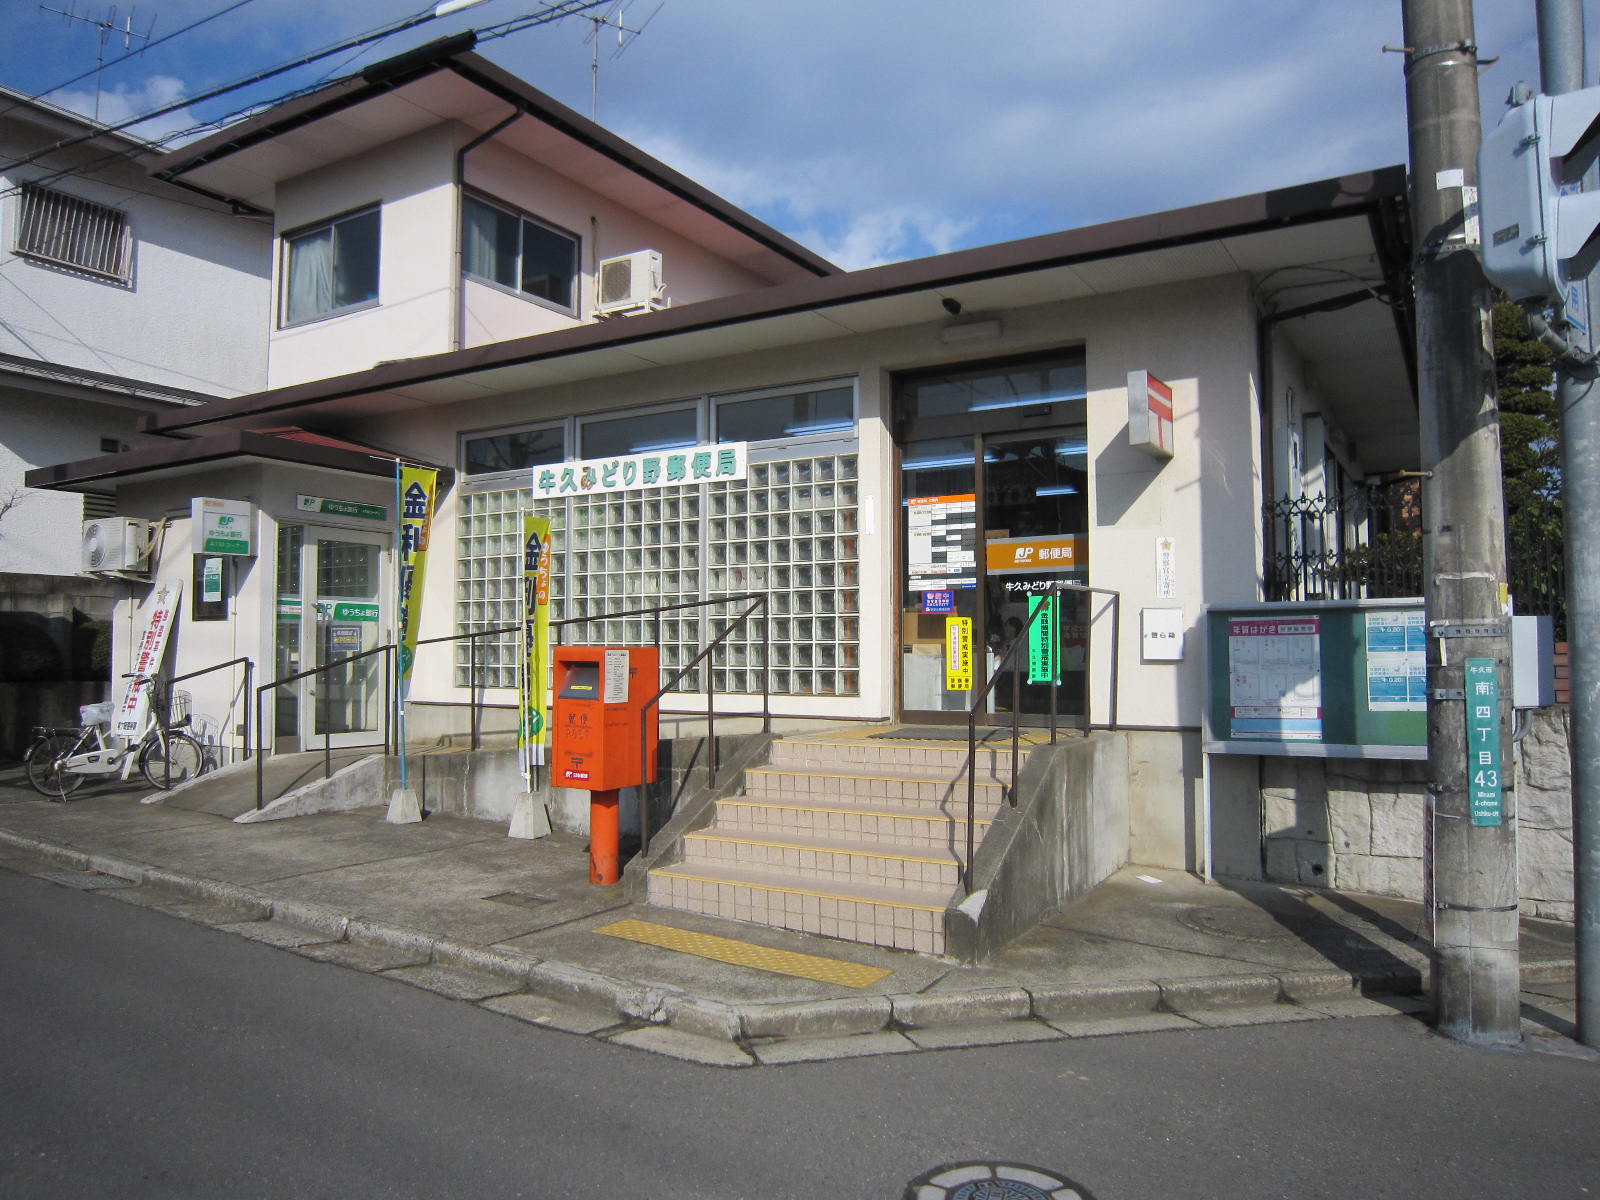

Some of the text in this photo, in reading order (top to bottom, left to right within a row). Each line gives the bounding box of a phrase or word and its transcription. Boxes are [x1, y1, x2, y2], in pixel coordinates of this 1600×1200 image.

[538, 448, 737, 494] 牛久みどり野郵便局
[328, 504, 358, 513] ゆうちょ銀行
[208, 529, 242, 538] ゆうちょ銀行
[1039, 547, 1072, 560] 郵便局
[537, 541, 548, 599] ゆうちょの
[342, 608, 378, 618] ゆうちょ銀行
[1232, 625, 1276, 634] 年賀はがき
[1041, 613, 1049, 679] 金融機関特別警戒実施中
[1470, 666, 1492, 674] 牛久市
[1474, 681, 1492, 765] 南四丁目
[1474, 770, 1497, 788] 43
